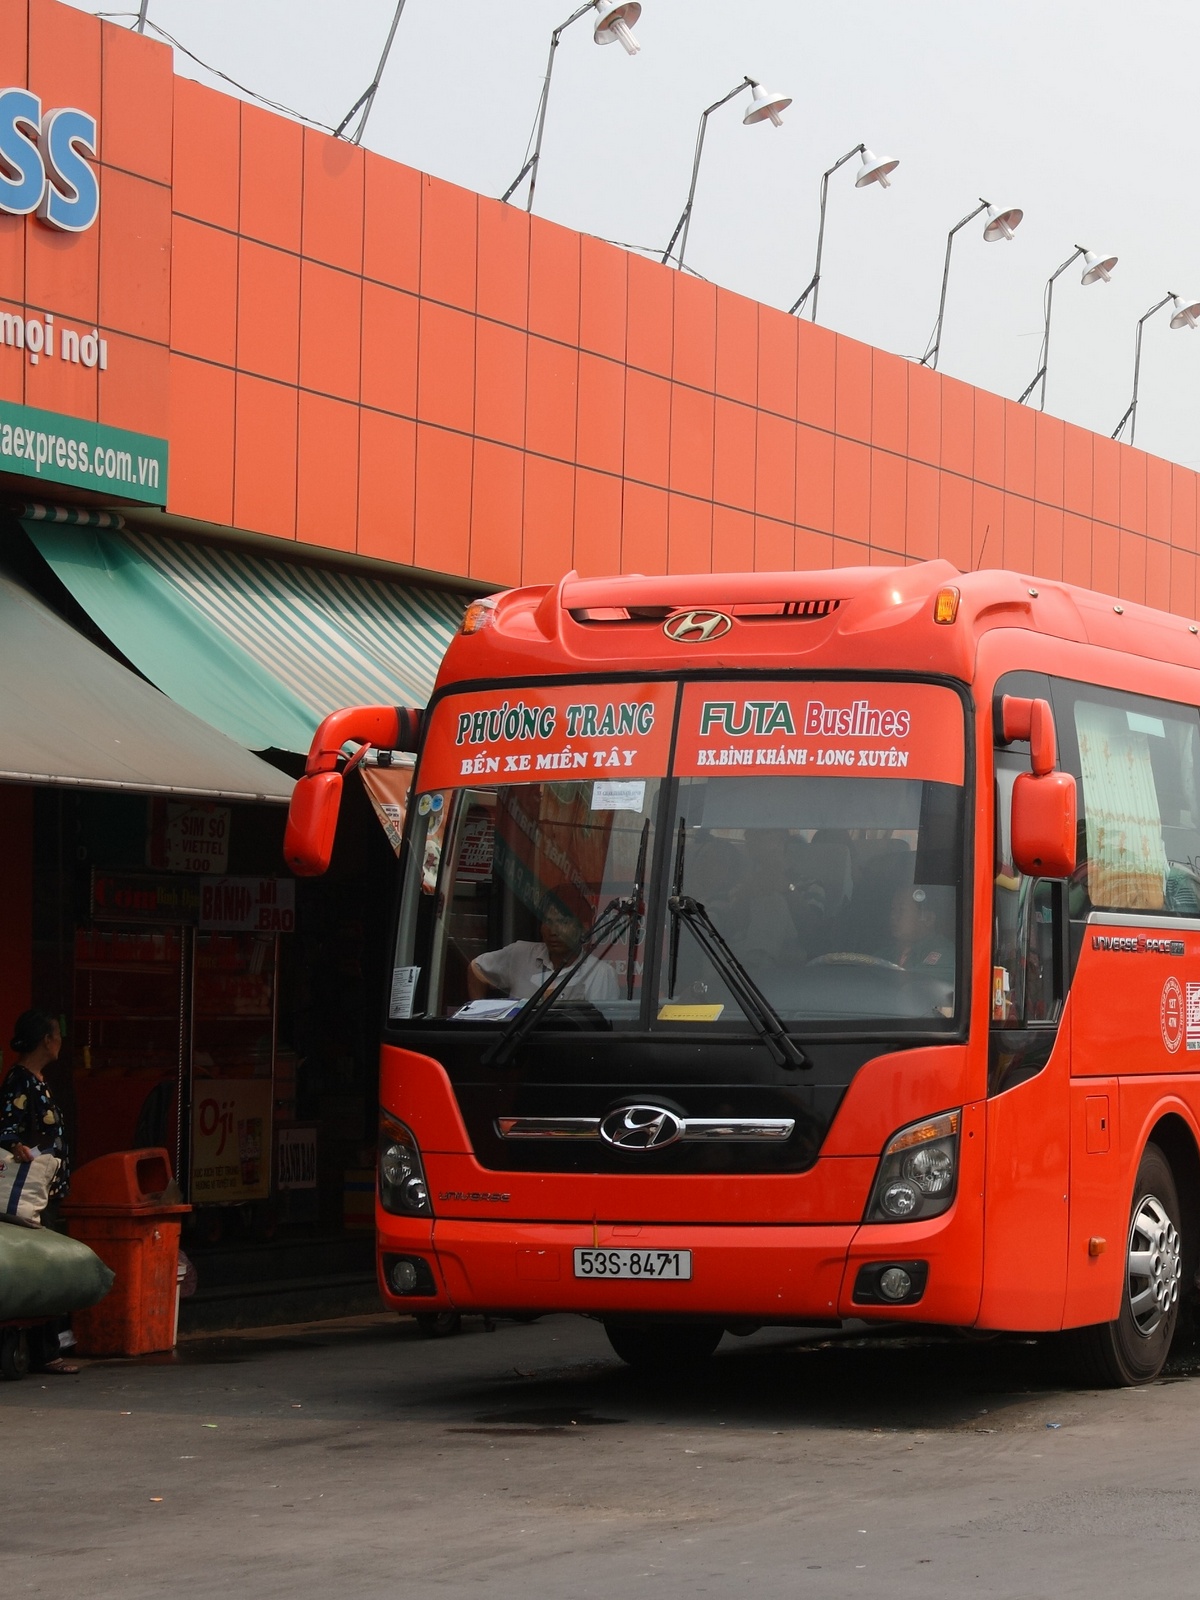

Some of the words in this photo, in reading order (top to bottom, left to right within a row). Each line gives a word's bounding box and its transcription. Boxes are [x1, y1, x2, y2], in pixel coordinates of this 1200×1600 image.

[0, 311, 53, 365] mọi
[0, 422, 159, 489] aexpress.com.vn
[455, 701, 556, 746] PHƯƠNG
[566, 702, 655, 738] TRANG
[699, 701, 796, 737] FUTA
[804, 701, 910, 737] Buslines
[460, 751, 501, 775] BẾN
[504, 755, 531, 773] XE
[535, 744, 588, 770] MIỀN
[593, 746, 637, 768] TÂY
[697, 746, 753, 766] BX.BÌNH
[756, 745, 807, 766] KHÁNH
[817, 750, 854, 766] LONG
[858, 746, 909, 767] XUYÊN
[181, 815, 205, 836] SIM
[208, 812, 227, 838] SỐ
[182, 839, 225, 856] VIETTEL
[184, 858, 210, 871] 100
[202, 879, 244, 921] BÁNH
[199, 1098, 235, 1156] Oji
[438, 1191, 511, 1203] UNIVERSE
